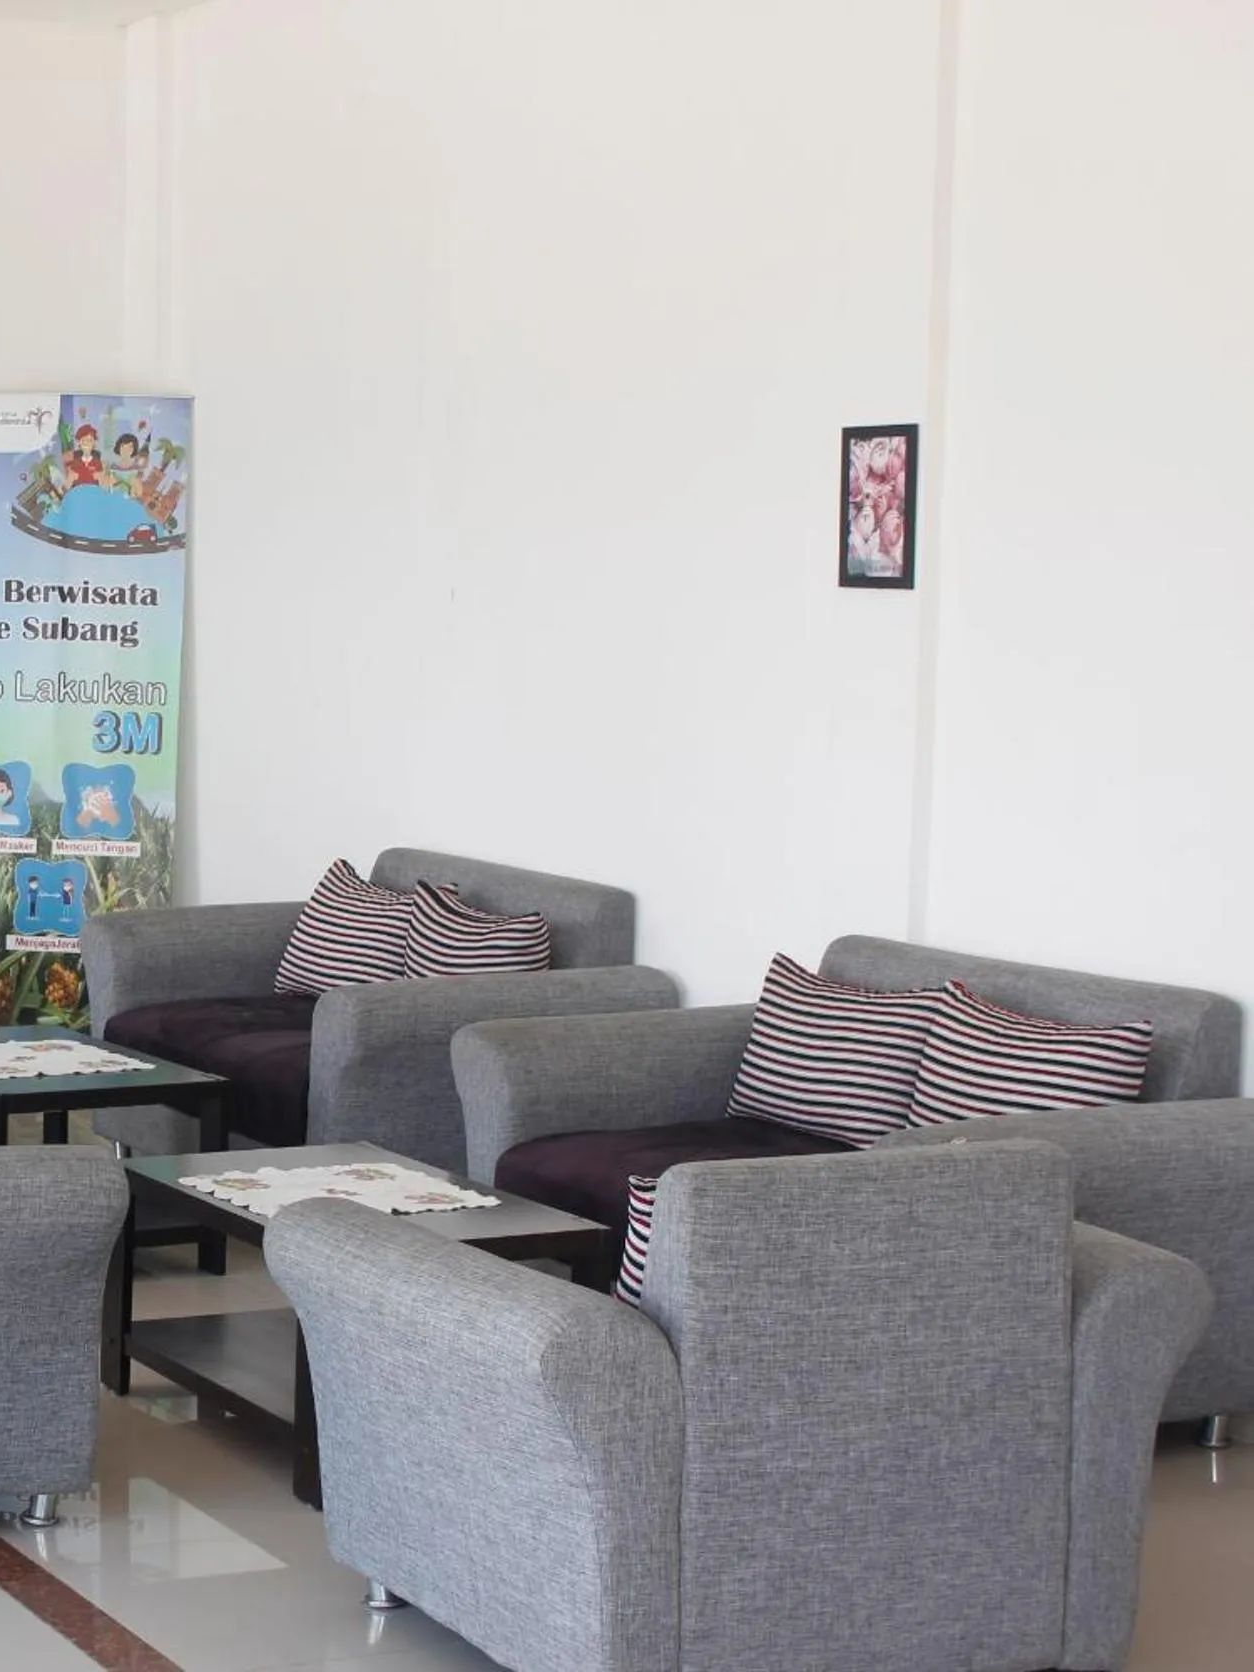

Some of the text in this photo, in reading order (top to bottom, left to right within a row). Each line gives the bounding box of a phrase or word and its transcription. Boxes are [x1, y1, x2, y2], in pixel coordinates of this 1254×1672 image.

[3, 579, 159, 606] Berwisata
[22, 615, 140, 649] Subang
[14, 670, 167, 706] Lakukan
[92, 709, 163, 756] 3M
